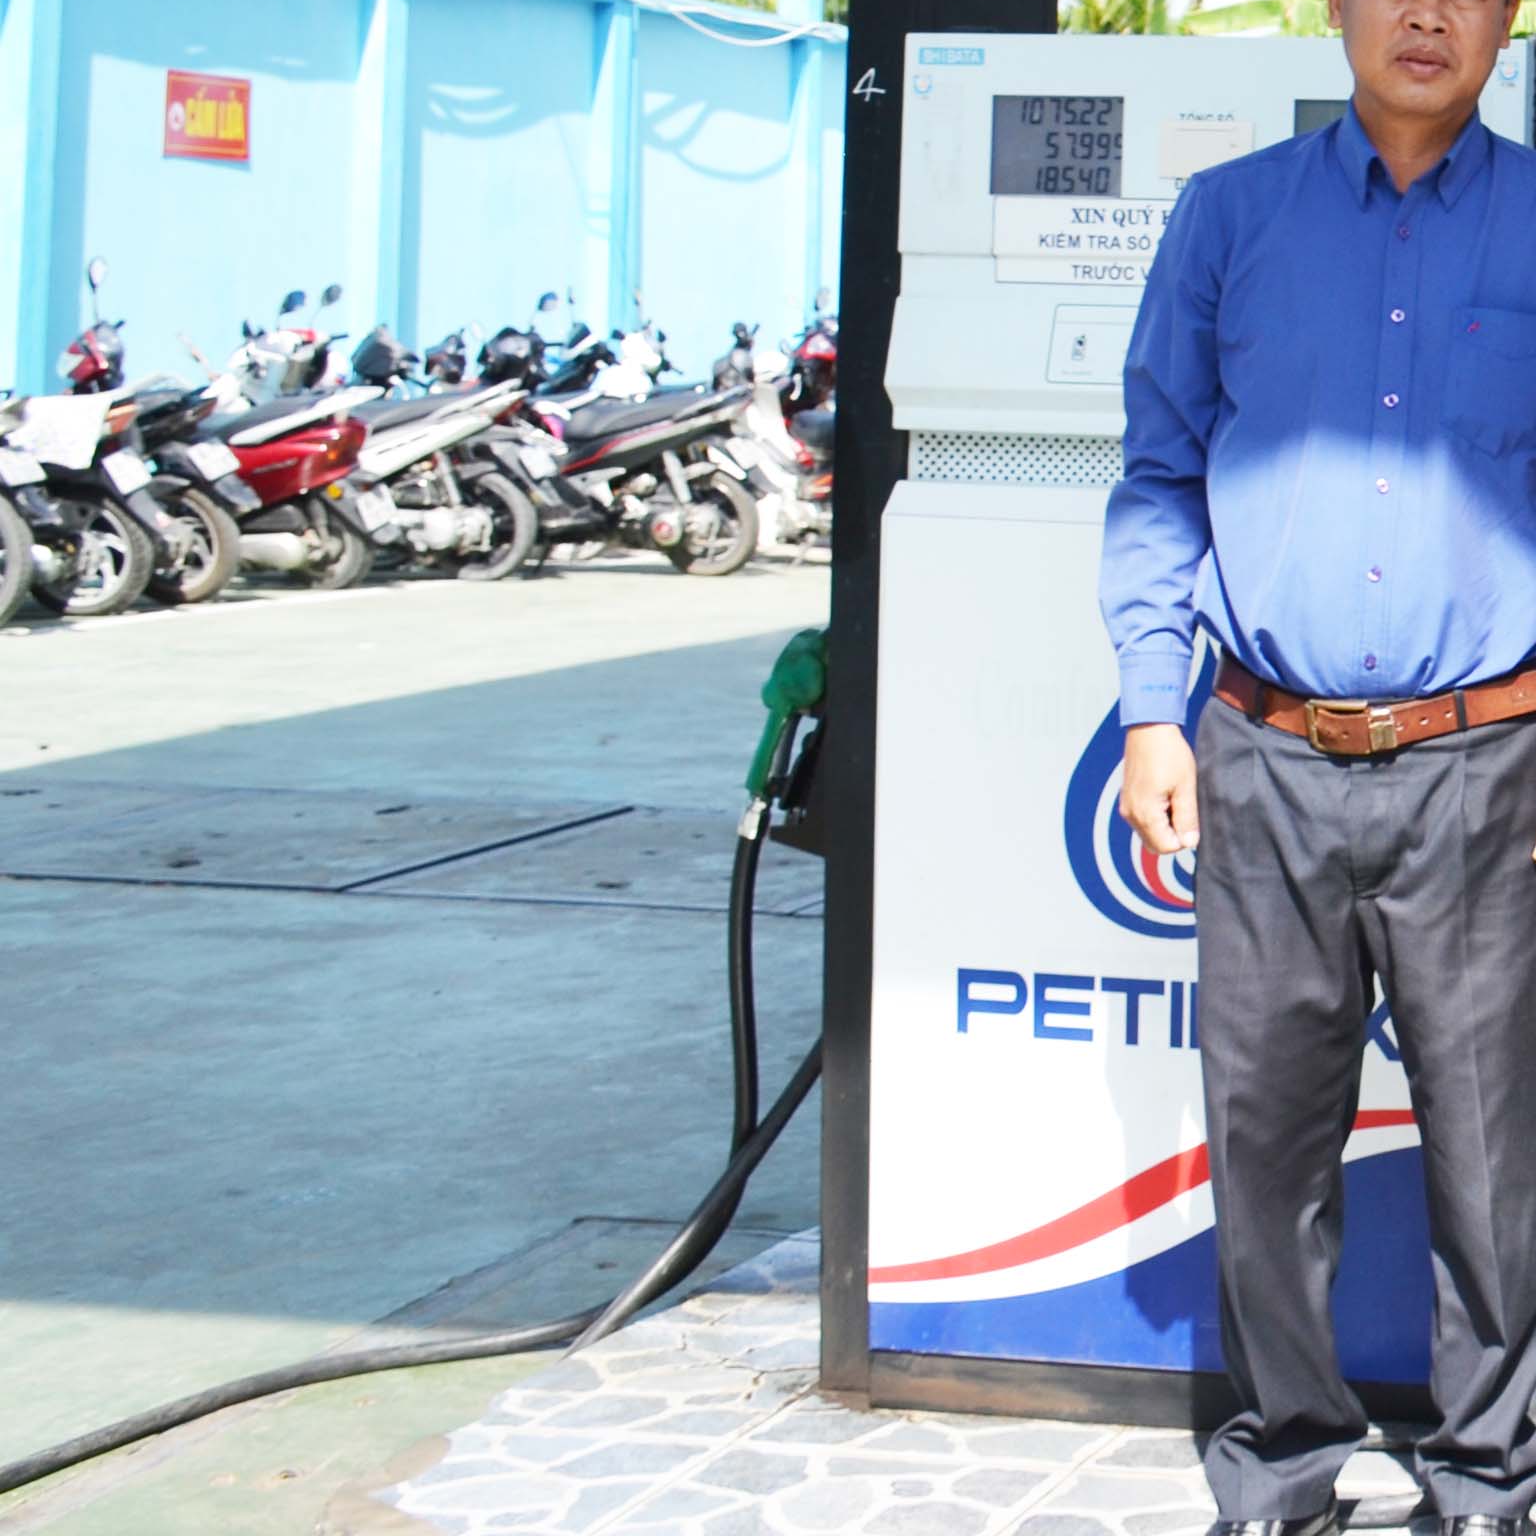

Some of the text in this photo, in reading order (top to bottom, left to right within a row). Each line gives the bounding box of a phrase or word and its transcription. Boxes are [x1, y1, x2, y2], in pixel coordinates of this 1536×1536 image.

[851, 67, 886, 102] 4
[1071, 207, 1106, 224] XIN
[1112, 204, 1154, 229] QUÝ
[1087, 234, 1121, 250] TRA
